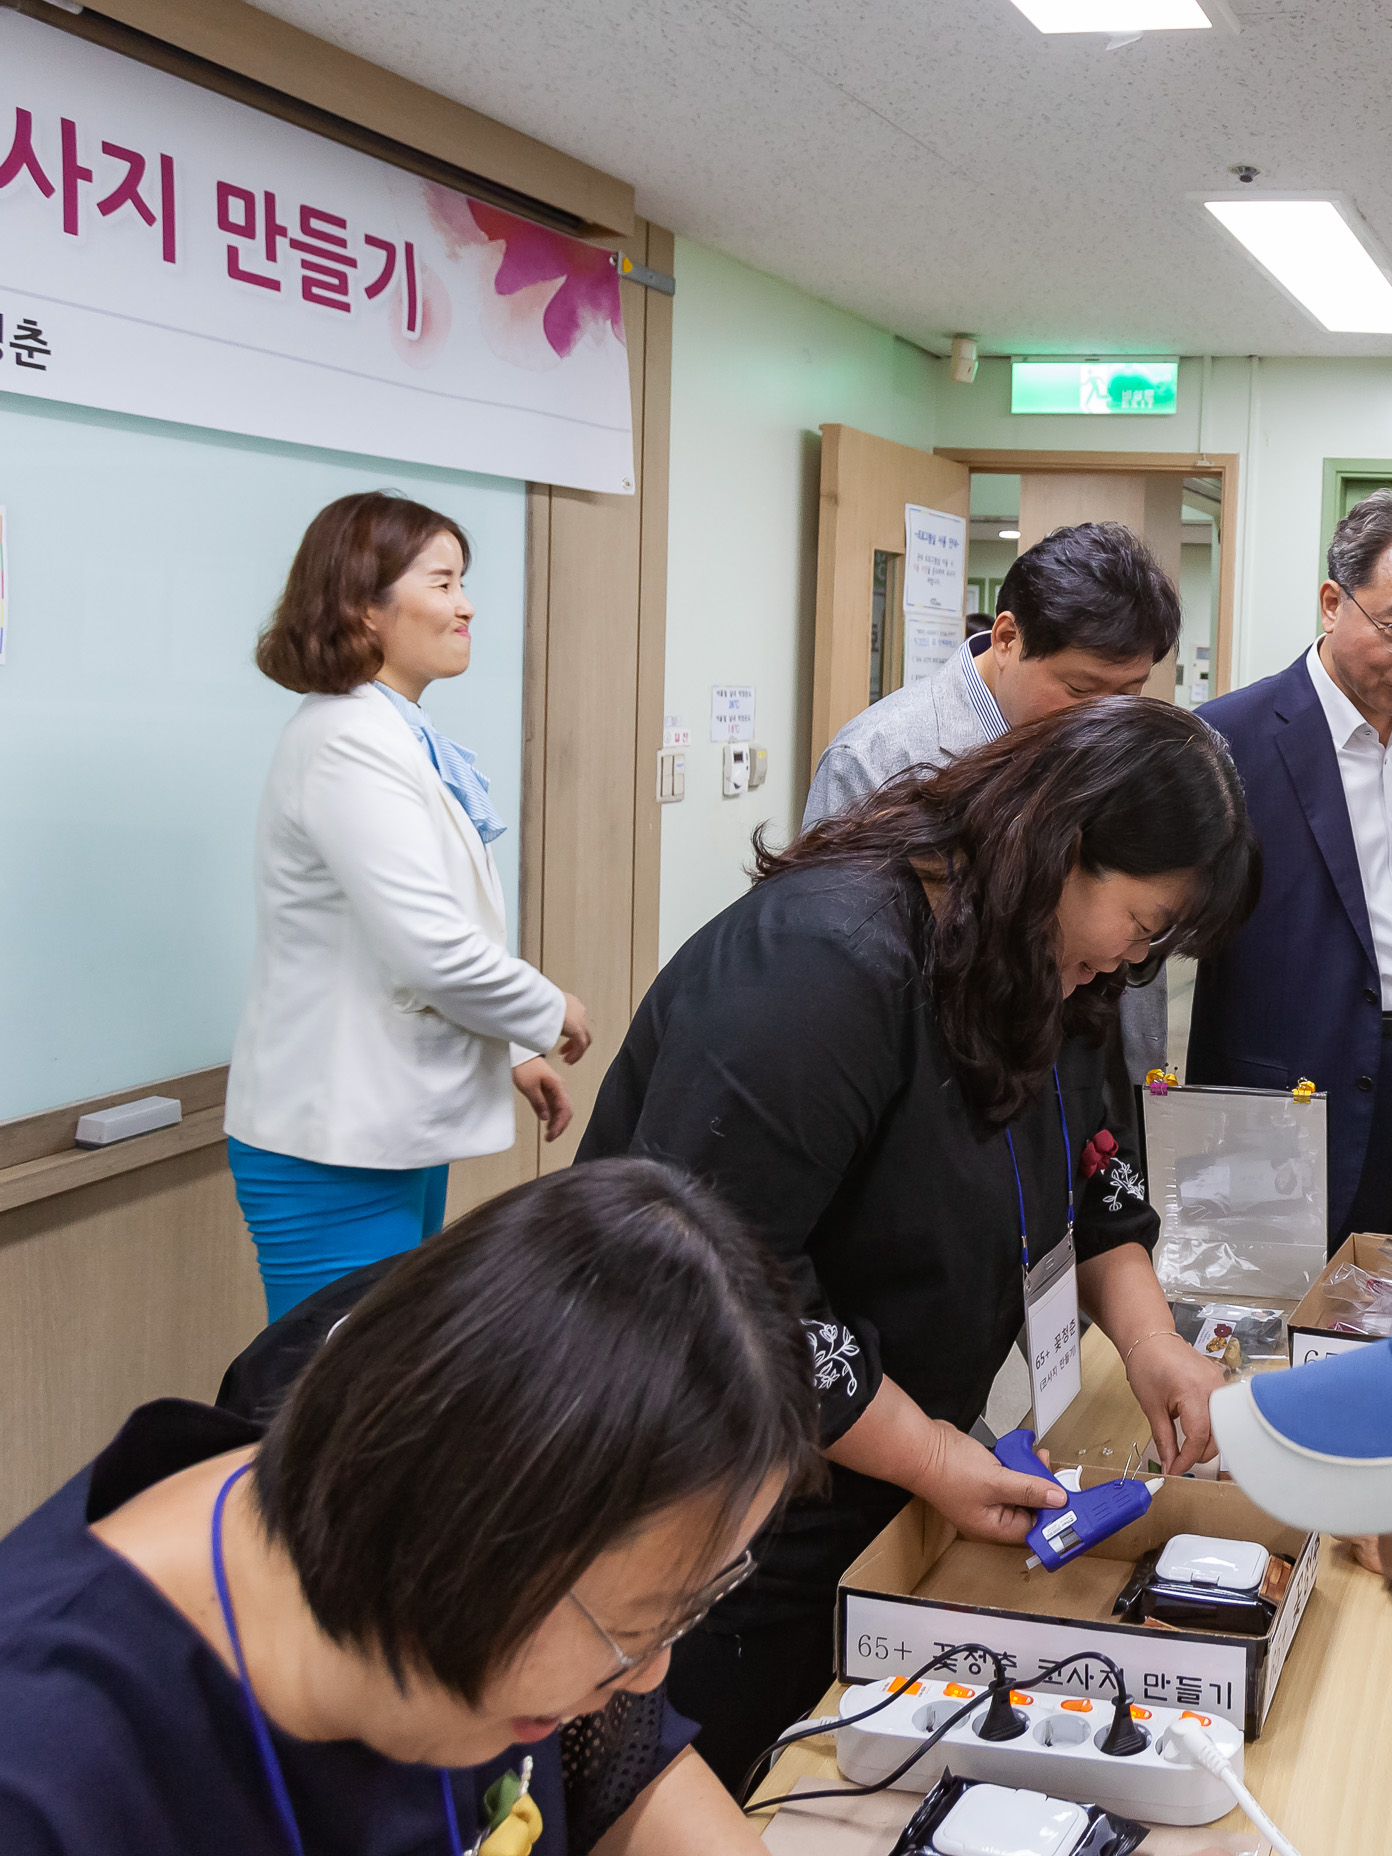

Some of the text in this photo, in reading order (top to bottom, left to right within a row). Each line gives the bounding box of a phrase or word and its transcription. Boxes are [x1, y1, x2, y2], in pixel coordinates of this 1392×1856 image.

[216, 179, 421, 333] 만들기
[0, 312, 52, 371] 춘
[1035, 1317, 1077, 1370] 65+ 꽃청춘
[857, 1633, 1232, 1710] 65+ 꽃청춘 코사지 만들기
